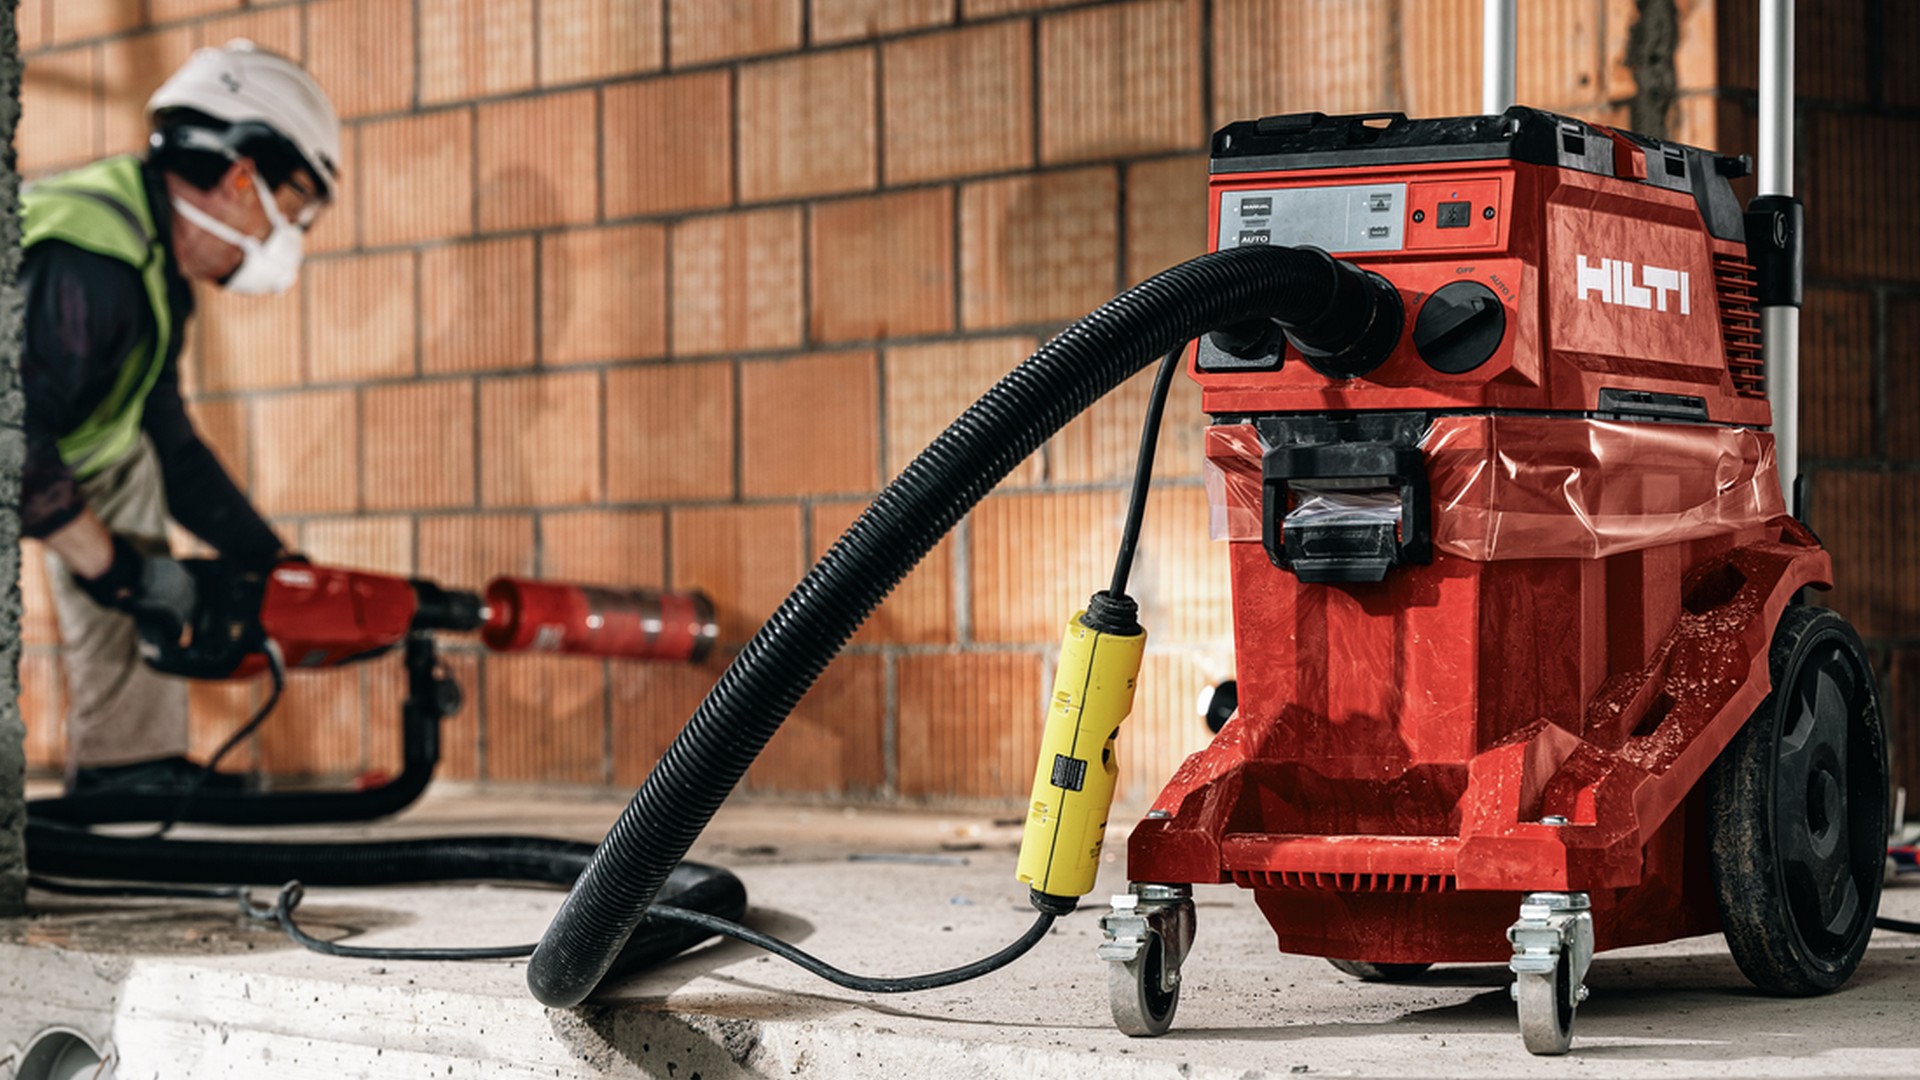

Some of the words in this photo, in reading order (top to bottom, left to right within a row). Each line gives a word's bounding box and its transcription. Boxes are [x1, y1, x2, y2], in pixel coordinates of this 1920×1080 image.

[1240, 235, 1269, 244] AUTO
[1490, 275, 1510, 296] AUTO
[1576, 254, 1690, 315] HILTI
